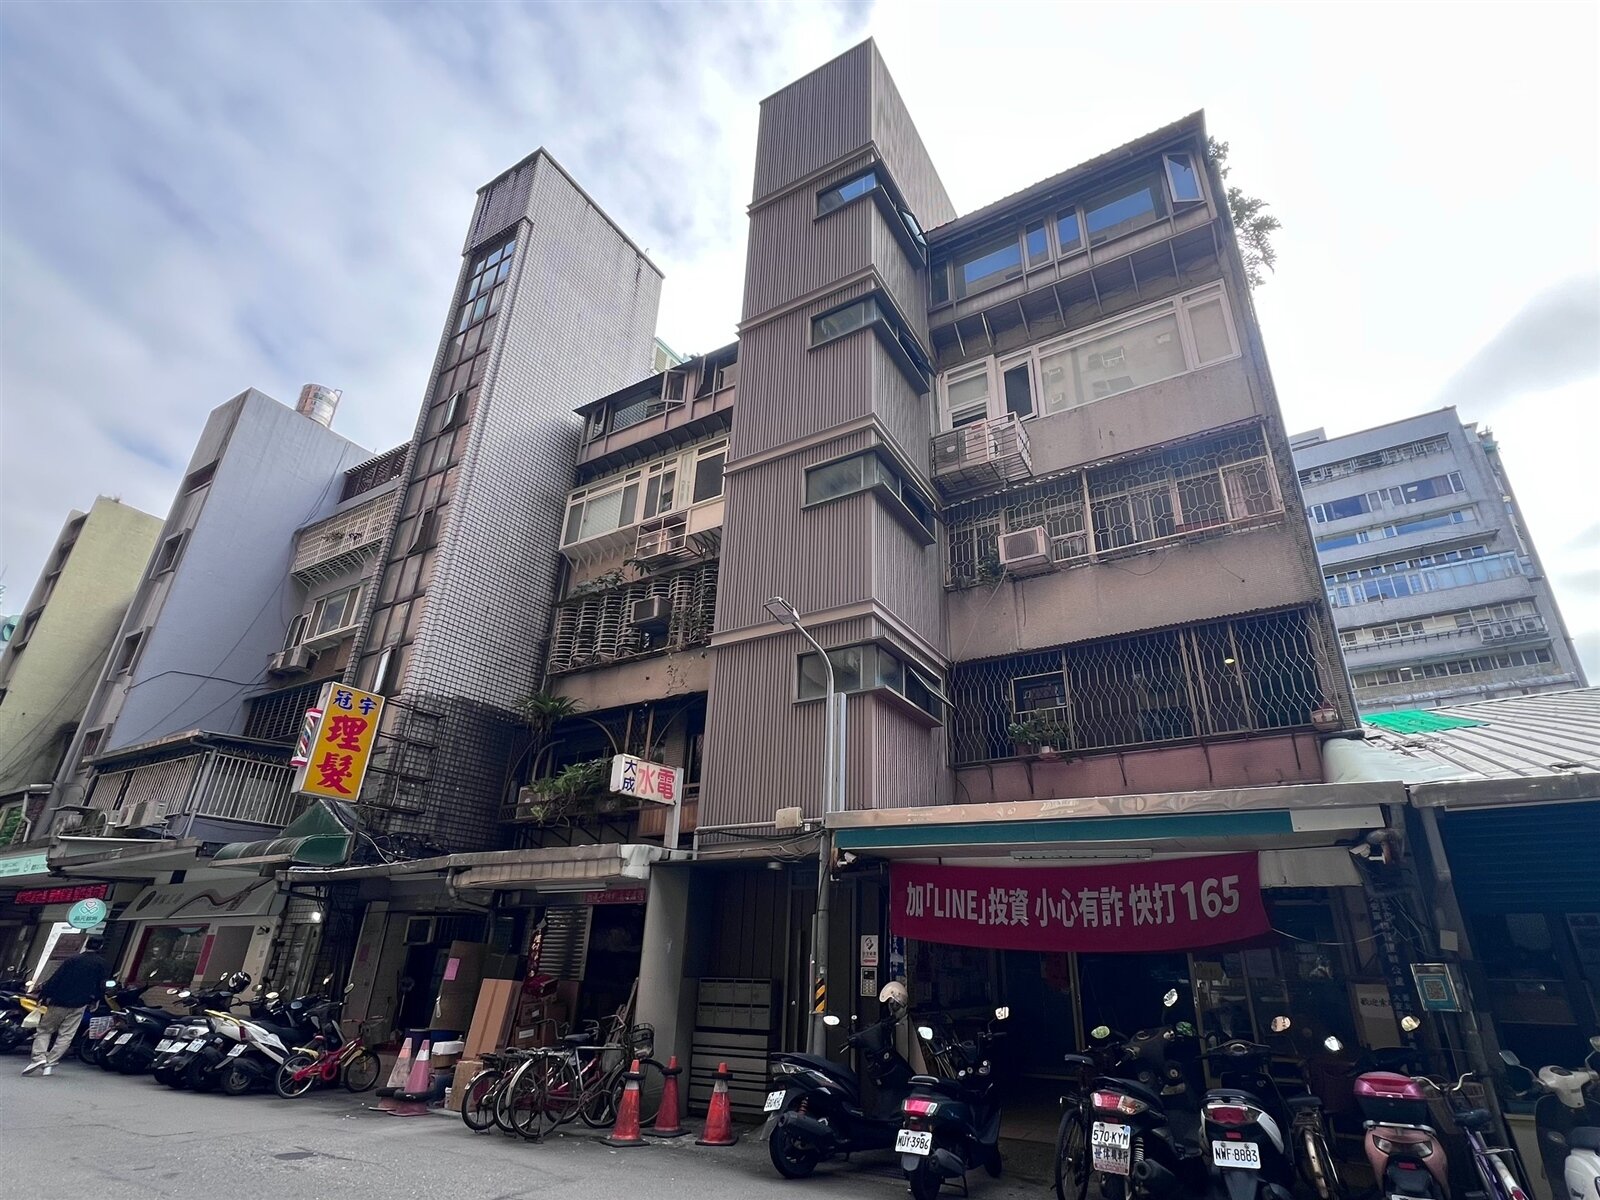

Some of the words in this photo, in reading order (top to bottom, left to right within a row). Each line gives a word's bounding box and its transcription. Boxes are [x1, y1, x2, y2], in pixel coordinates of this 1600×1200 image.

[333, 690, 377, 715] 冠宇
[316, 714, 368, 794] 理髮
[622, 759, 638, 793] 大成
[637, 765, 675, 799] 水電
[1035, 887, 1124, 928] 小心有詐
